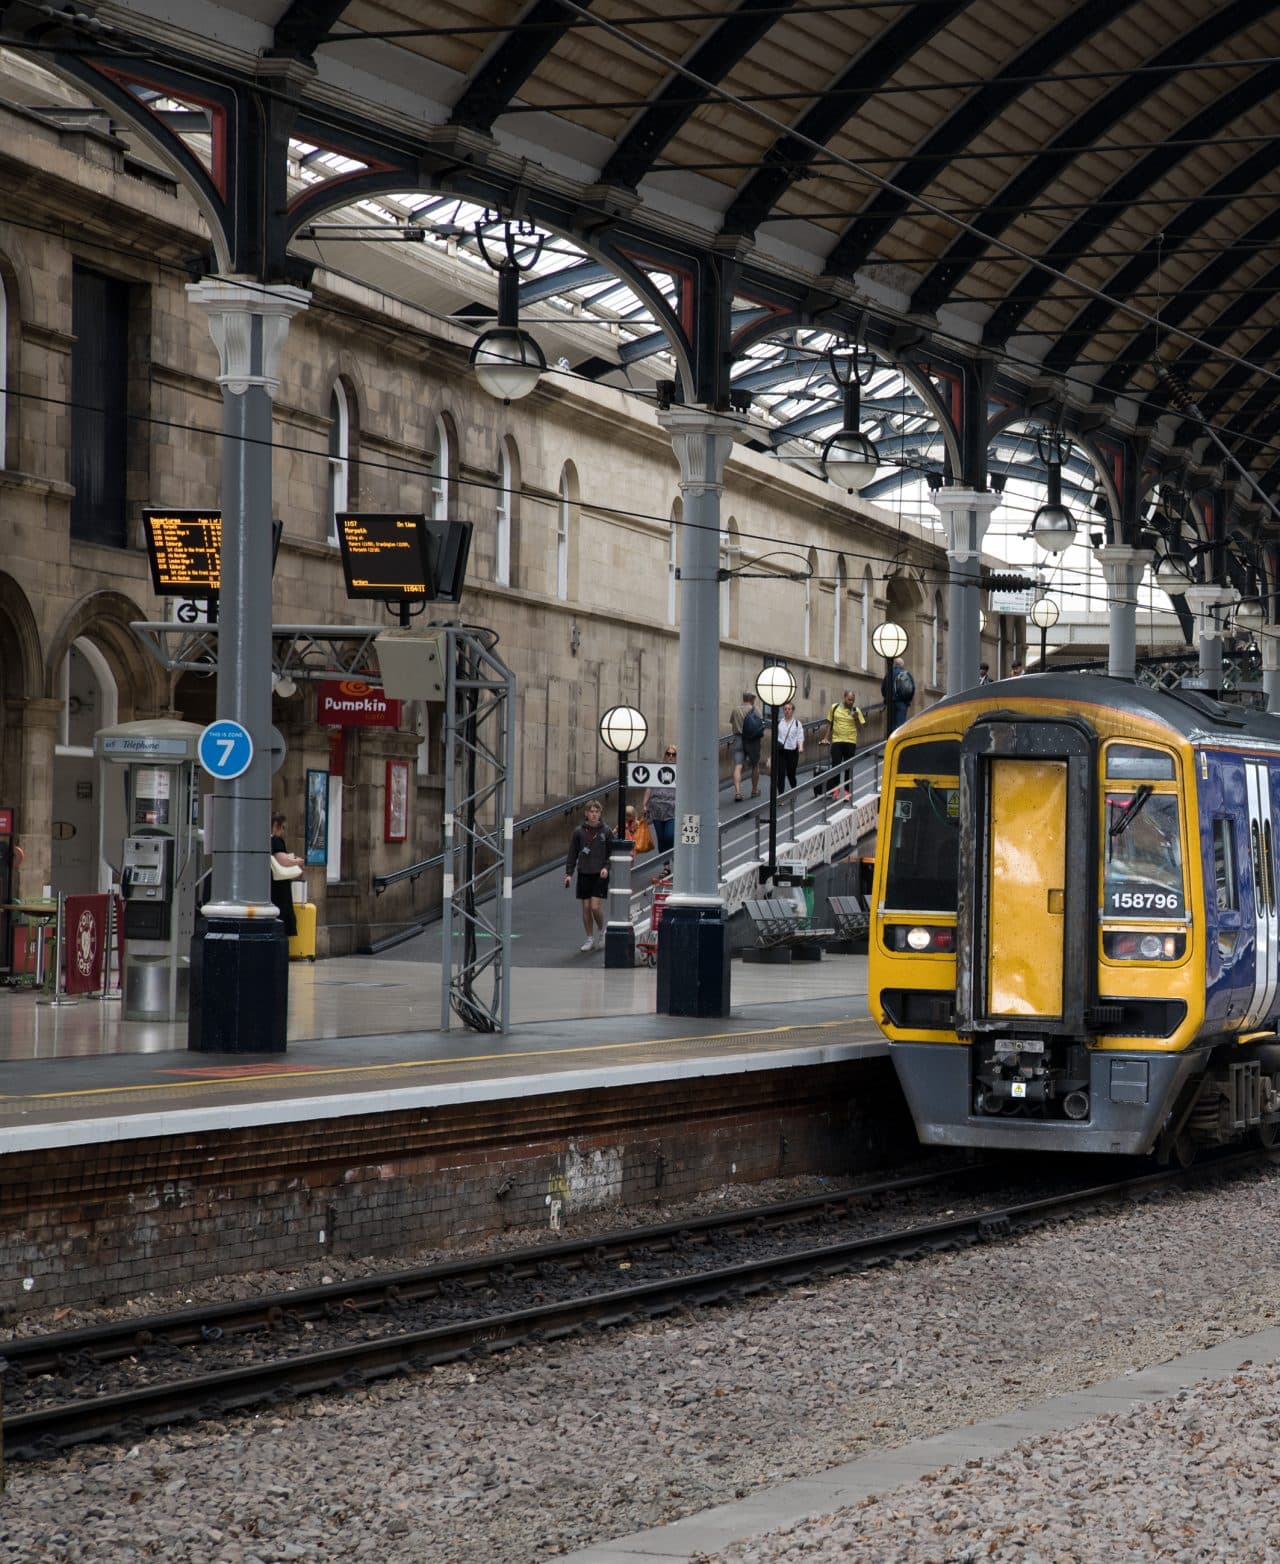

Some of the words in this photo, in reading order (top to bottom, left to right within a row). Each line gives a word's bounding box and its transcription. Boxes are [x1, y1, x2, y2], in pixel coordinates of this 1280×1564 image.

[325, 697, 387, 712] Pumpkin
[122, 740, 160, 750] Telephone
[216, 739, 235, 767] 7
[688, 815, 694, 823] E
[682, 826, 699, 834] 432
[685, 835, 696, 843] 35
[1111, 893, 1178, 909] 158796
